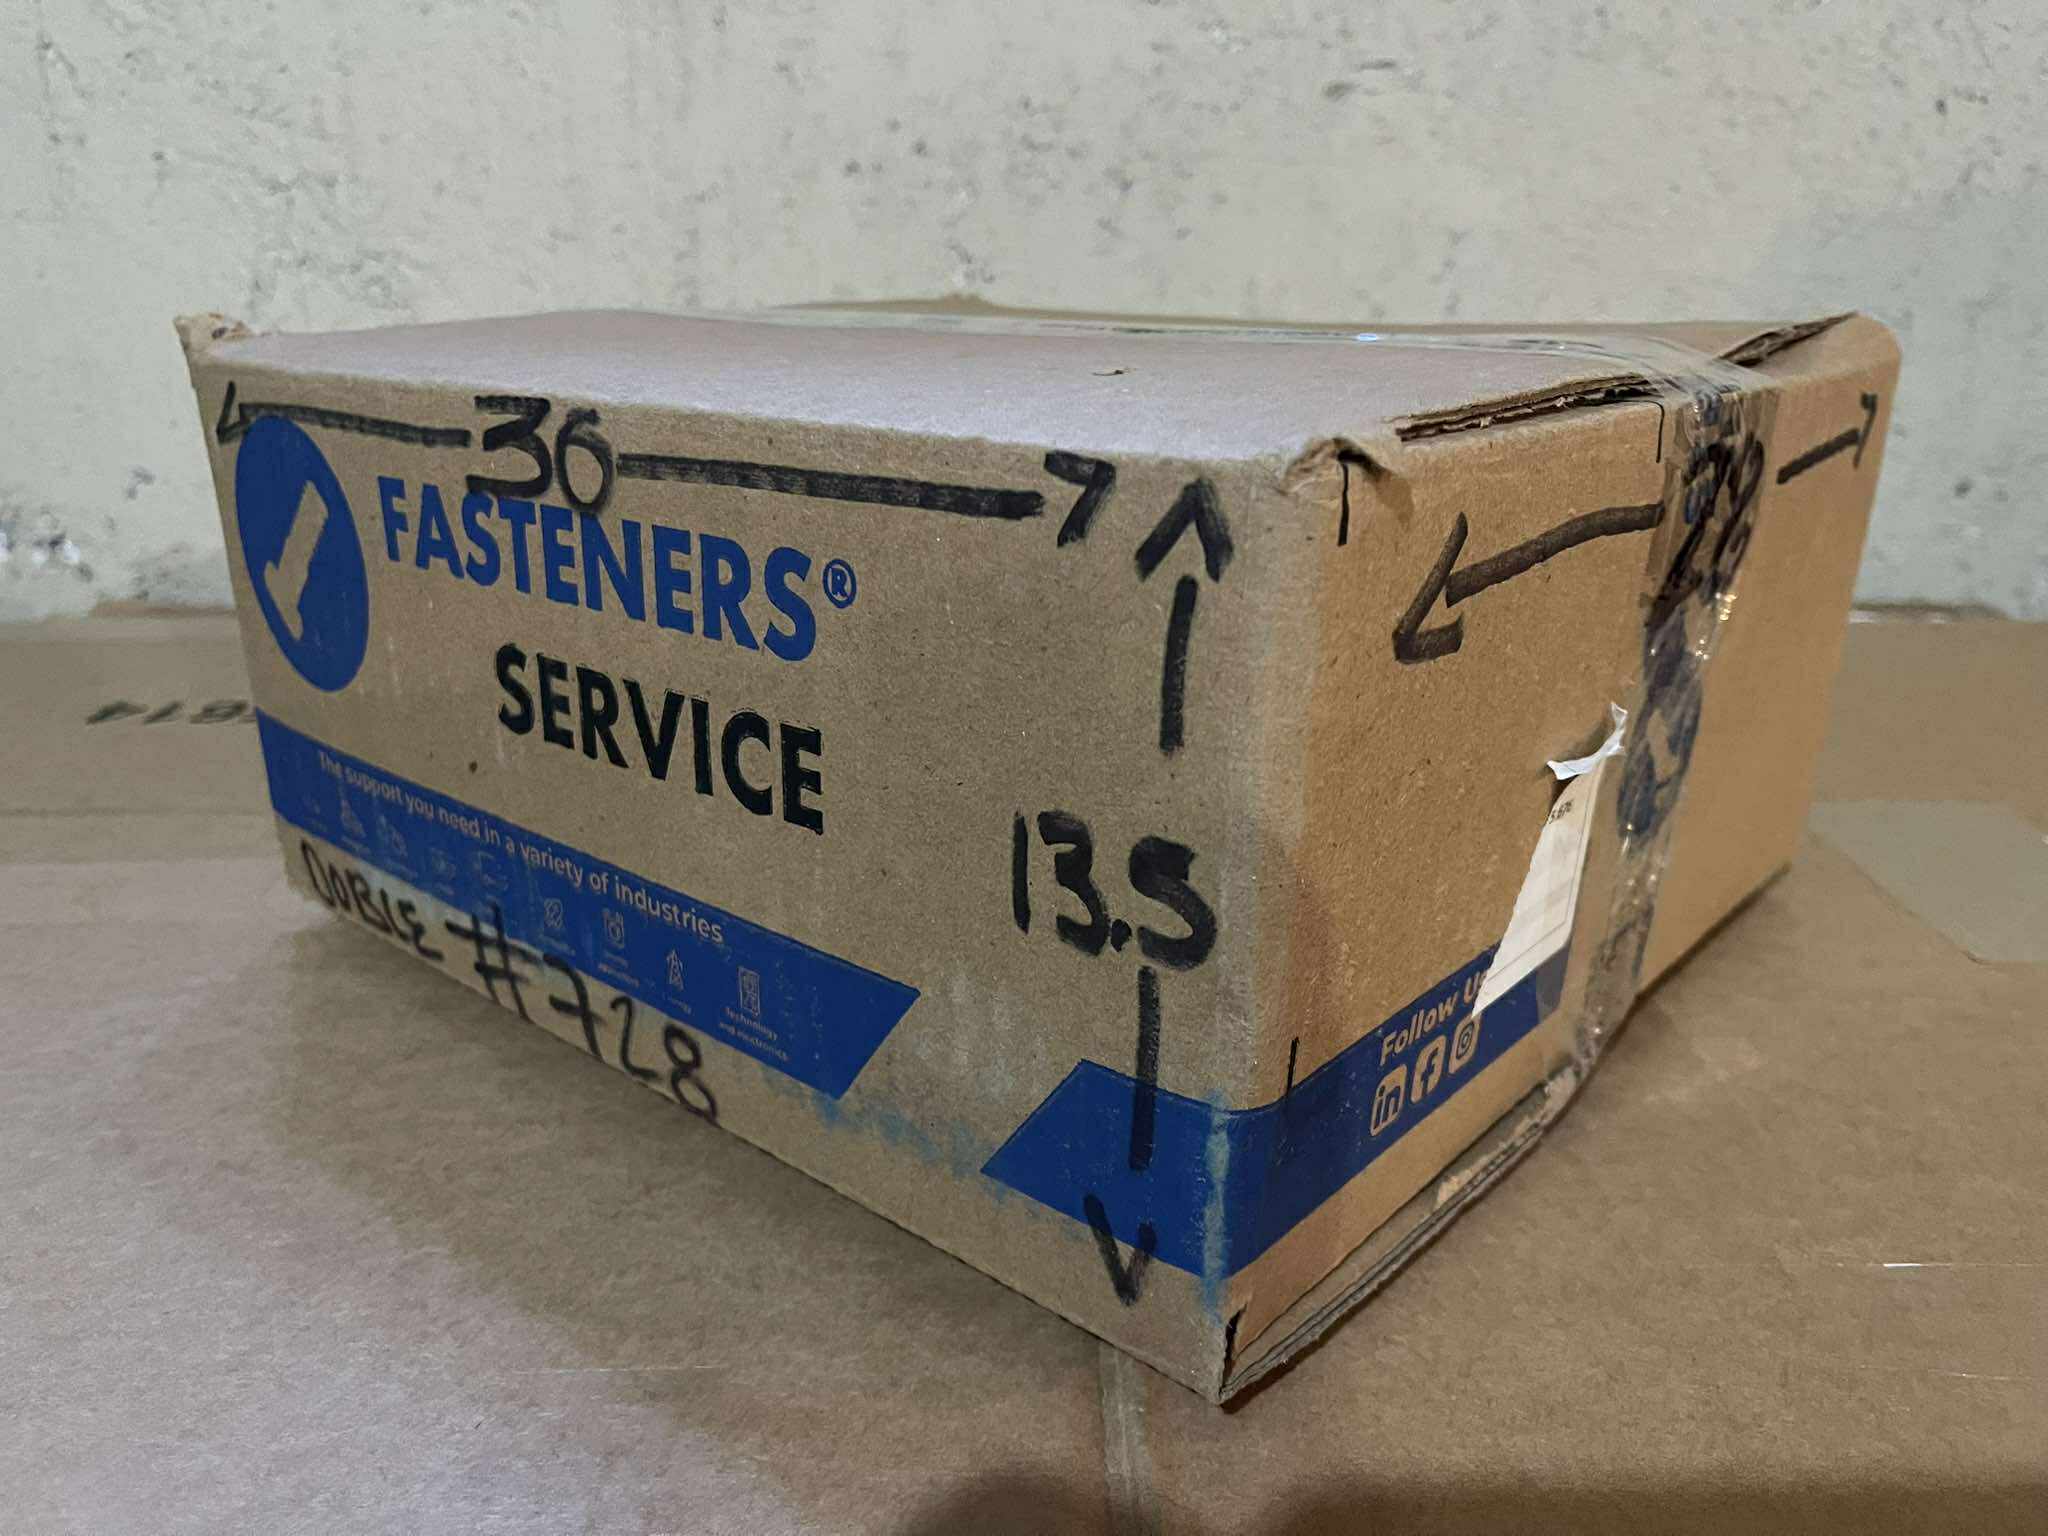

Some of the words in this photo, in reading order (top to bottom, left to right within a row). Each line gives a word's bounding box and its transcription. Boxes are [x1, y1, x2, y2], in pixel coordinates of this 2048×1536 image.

[466, 394, 617, 513] 36
[495, 642, 824, 836] SERVICE
[346, 766, 403, 804] support
[405, 793, 434, 818] you
[438, 803, 480, 836] need
[483, 820, 501, 846] in
[506, 836, 515, 853] a
[520, 843, 584, 888] variety
[589, 870, 609, 893] of
[615, 876, 724, 944] industries
[1380, 992, 1459, 1067] Follow
